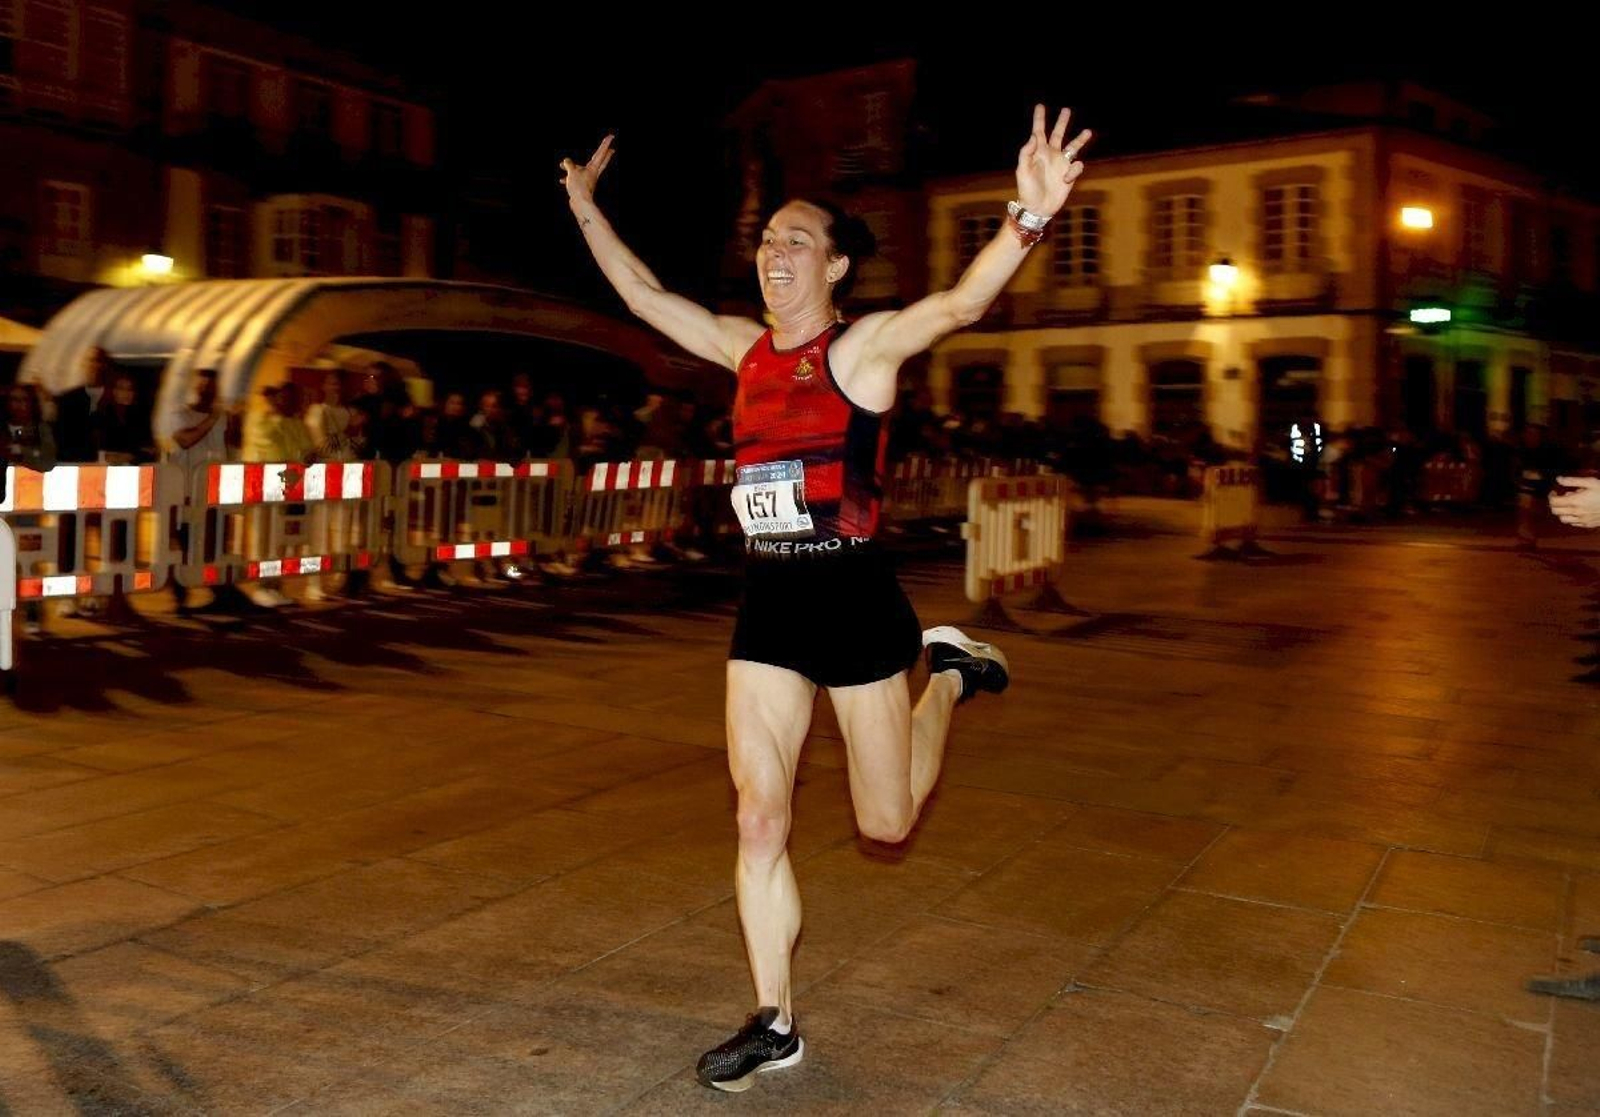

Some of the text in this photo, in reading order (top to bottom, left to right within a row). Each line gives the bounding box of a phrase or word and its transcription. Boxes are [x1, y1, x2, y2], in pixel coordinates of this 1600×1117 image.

[746, 490, 777, 520] 157
[754, 539, 792, 554] NIKE
[794, 538, 842, 554] PRO
